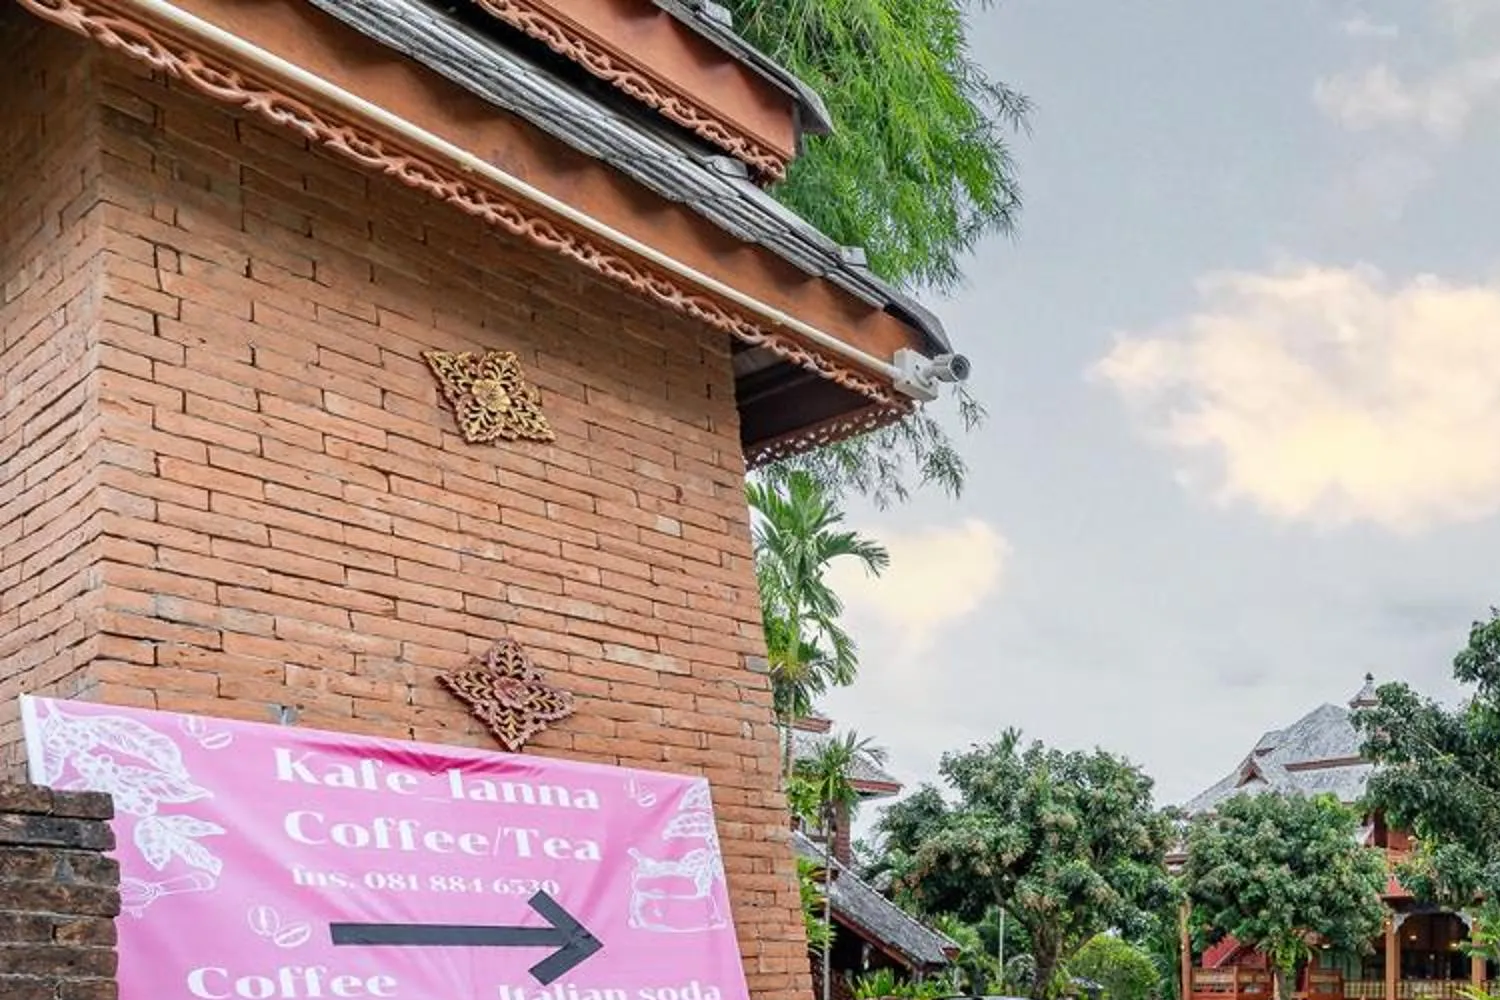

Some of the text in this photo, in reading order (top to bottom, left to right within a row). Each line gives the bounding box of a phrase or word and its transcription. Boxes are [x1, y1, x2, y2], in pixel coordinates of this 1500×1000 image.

[284, 810, 602, 861] Coffee/Tea
[364, 871, 419, 892] 081
[187, 966, 399, 1000] Coffee
